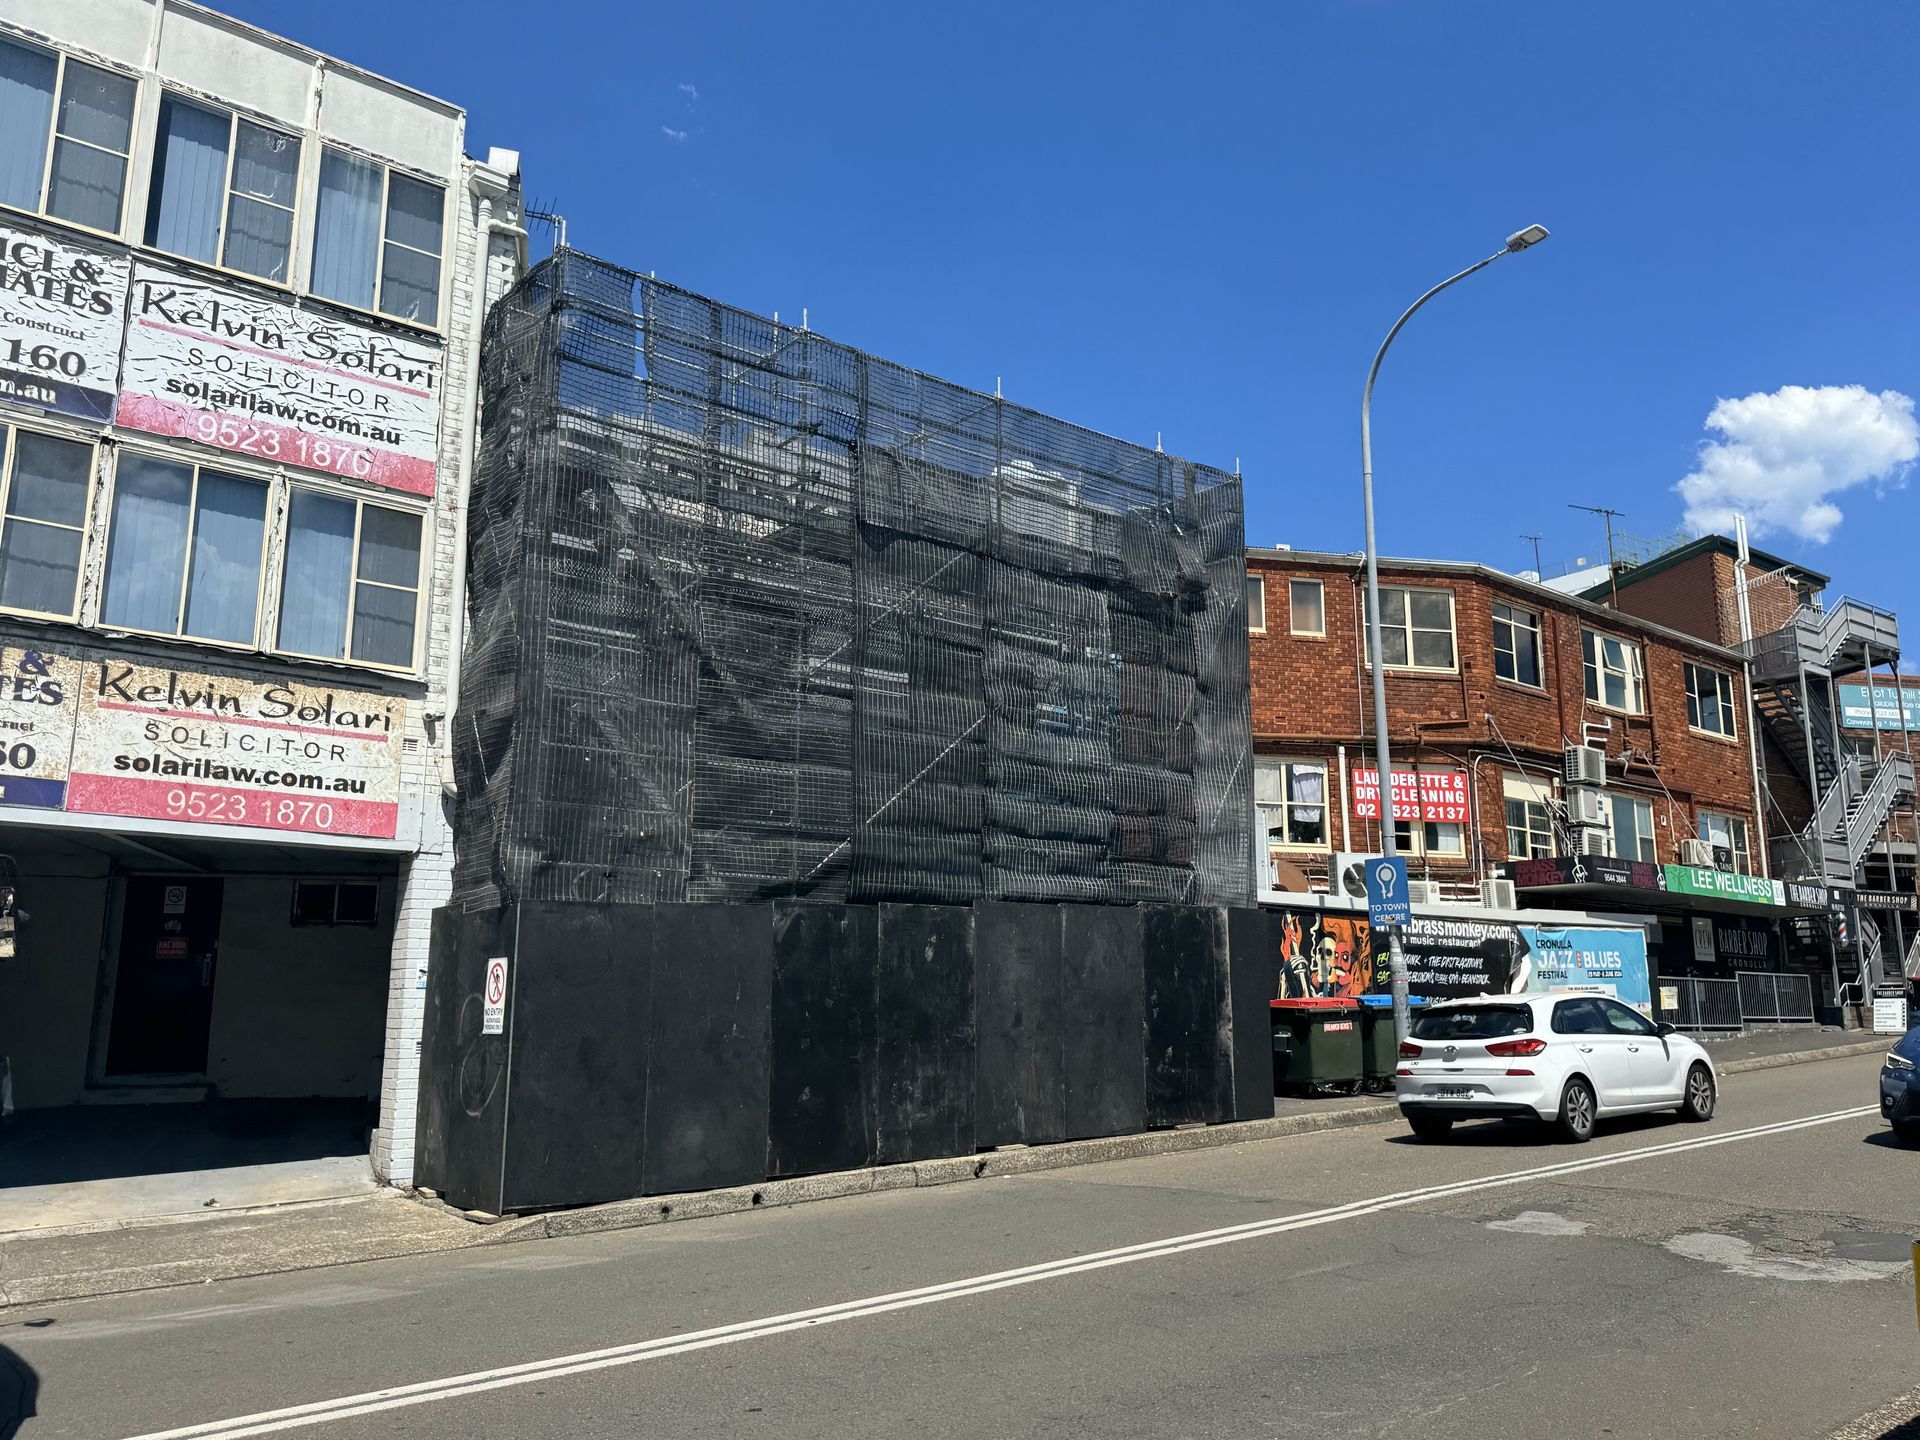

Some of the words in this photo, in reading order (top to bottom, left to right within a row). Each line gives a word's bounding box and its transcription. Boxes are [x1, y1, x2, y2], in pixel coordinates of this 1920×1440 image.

[69, 258, 105, 287] &
[141, 284, 284, 350] Kelvin
[302, 330, 433, 389] Solari
[188, 348, 390, 412] SOLICITOR
[166, 378, 401, 446] solarilaw.com.au
[197, 414, 282, 456] 9523
[19, 650, 55, 677] &
[98, 664, 242, 713] Kelvin
[258, 687, 392, 732] Solari
[144, 722, 346, 762] SOLICITOR
[114, 753, 366, 794] solarilaw.com.au
[1354, 772, 1449, 788] LAUDERETTE
[1454, 775, 1464, 788] &
[1392, 790, 1465, 804] CLEANING
[166, 789, 247, 821] 9523
[260, 799, 334, 828] 1870
[1357, 803, 1376, 817] 02
[1393, 804, 1421, 818] 523
[1427, 806, 1465, 820] 2137
[1516, 859, 1556, 873] BRASS
[1516, 870, 1566, 886] MONKEY
[1691, 870, 1713, 890] LEE
[1713, 870, 1772, 898] WELLNESS
[1789, 884, 1799, 901] THE
[1798, 885, 1816, 904] BARBER
[1816, 888, 1827, 906] SHOP
[1857, 894, 1867, 902] THE
[1868, 895, 1891, 903] BARBER
[1892, 896, 1908, 905] SHOP
[1383, 903, 1408, 911] TOWN
[1375, 913, 1405, 922] CENTRE
[1410, 935, 1435, 945] music
[1438, 937, 1481, 949] restaurant
[1536, 940, 1573, 949] CRONULLA
[1718, 928, 1747, 955] BARBER
[1748, 931, 1767, 956] SHOP
[1377, 952, 1390, 965] FRI
[1428, 955, 1441, 967] THE
[1537, 951, 1574, 968] JAZZ
[1583, 951, 1622, 968] BLUES
[1728, 958, 1767, 968] CRONULLA
[1377, 971, 1390, 982] SAT
[1538, 971, 1568, 979] FESTIVAL
[485, 1008, 490, 1016] NO
[491, 1008, 503, 1016] ENTRY
